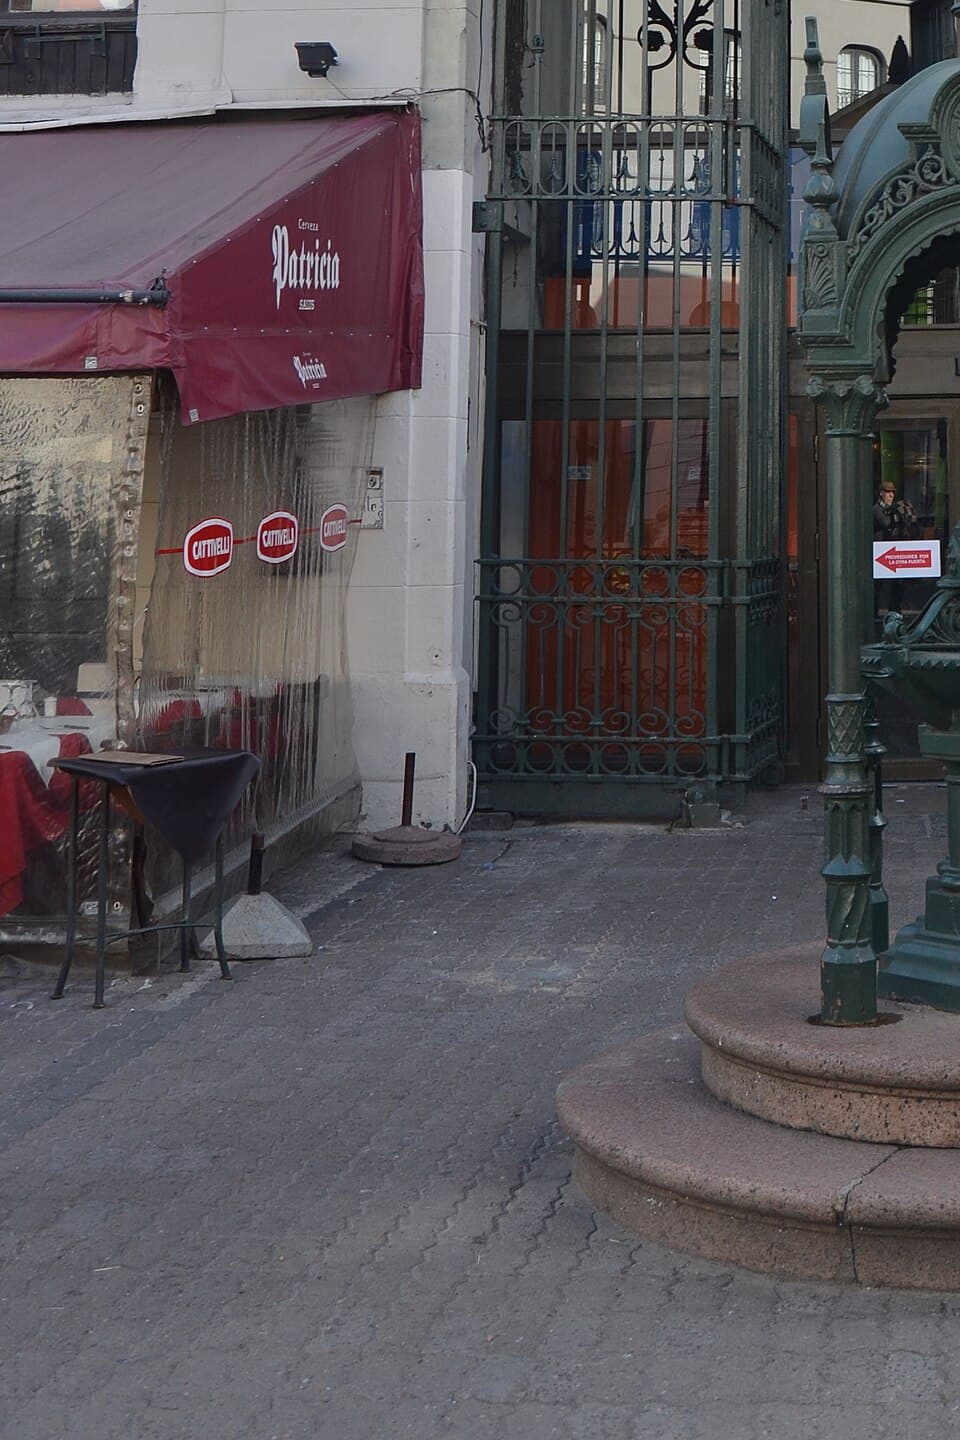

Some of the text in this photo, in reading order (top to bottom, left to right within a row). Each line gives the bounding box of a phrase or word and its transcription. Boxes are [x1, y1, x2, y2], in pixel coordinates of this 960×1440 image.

[298, 218, 319, 231] Cerveza
[272, 224, 340, 310] Patricia
[192, 536, 230, 560] CATTIVELLI
[262, 527, 295, 548] CATTIVELLI
